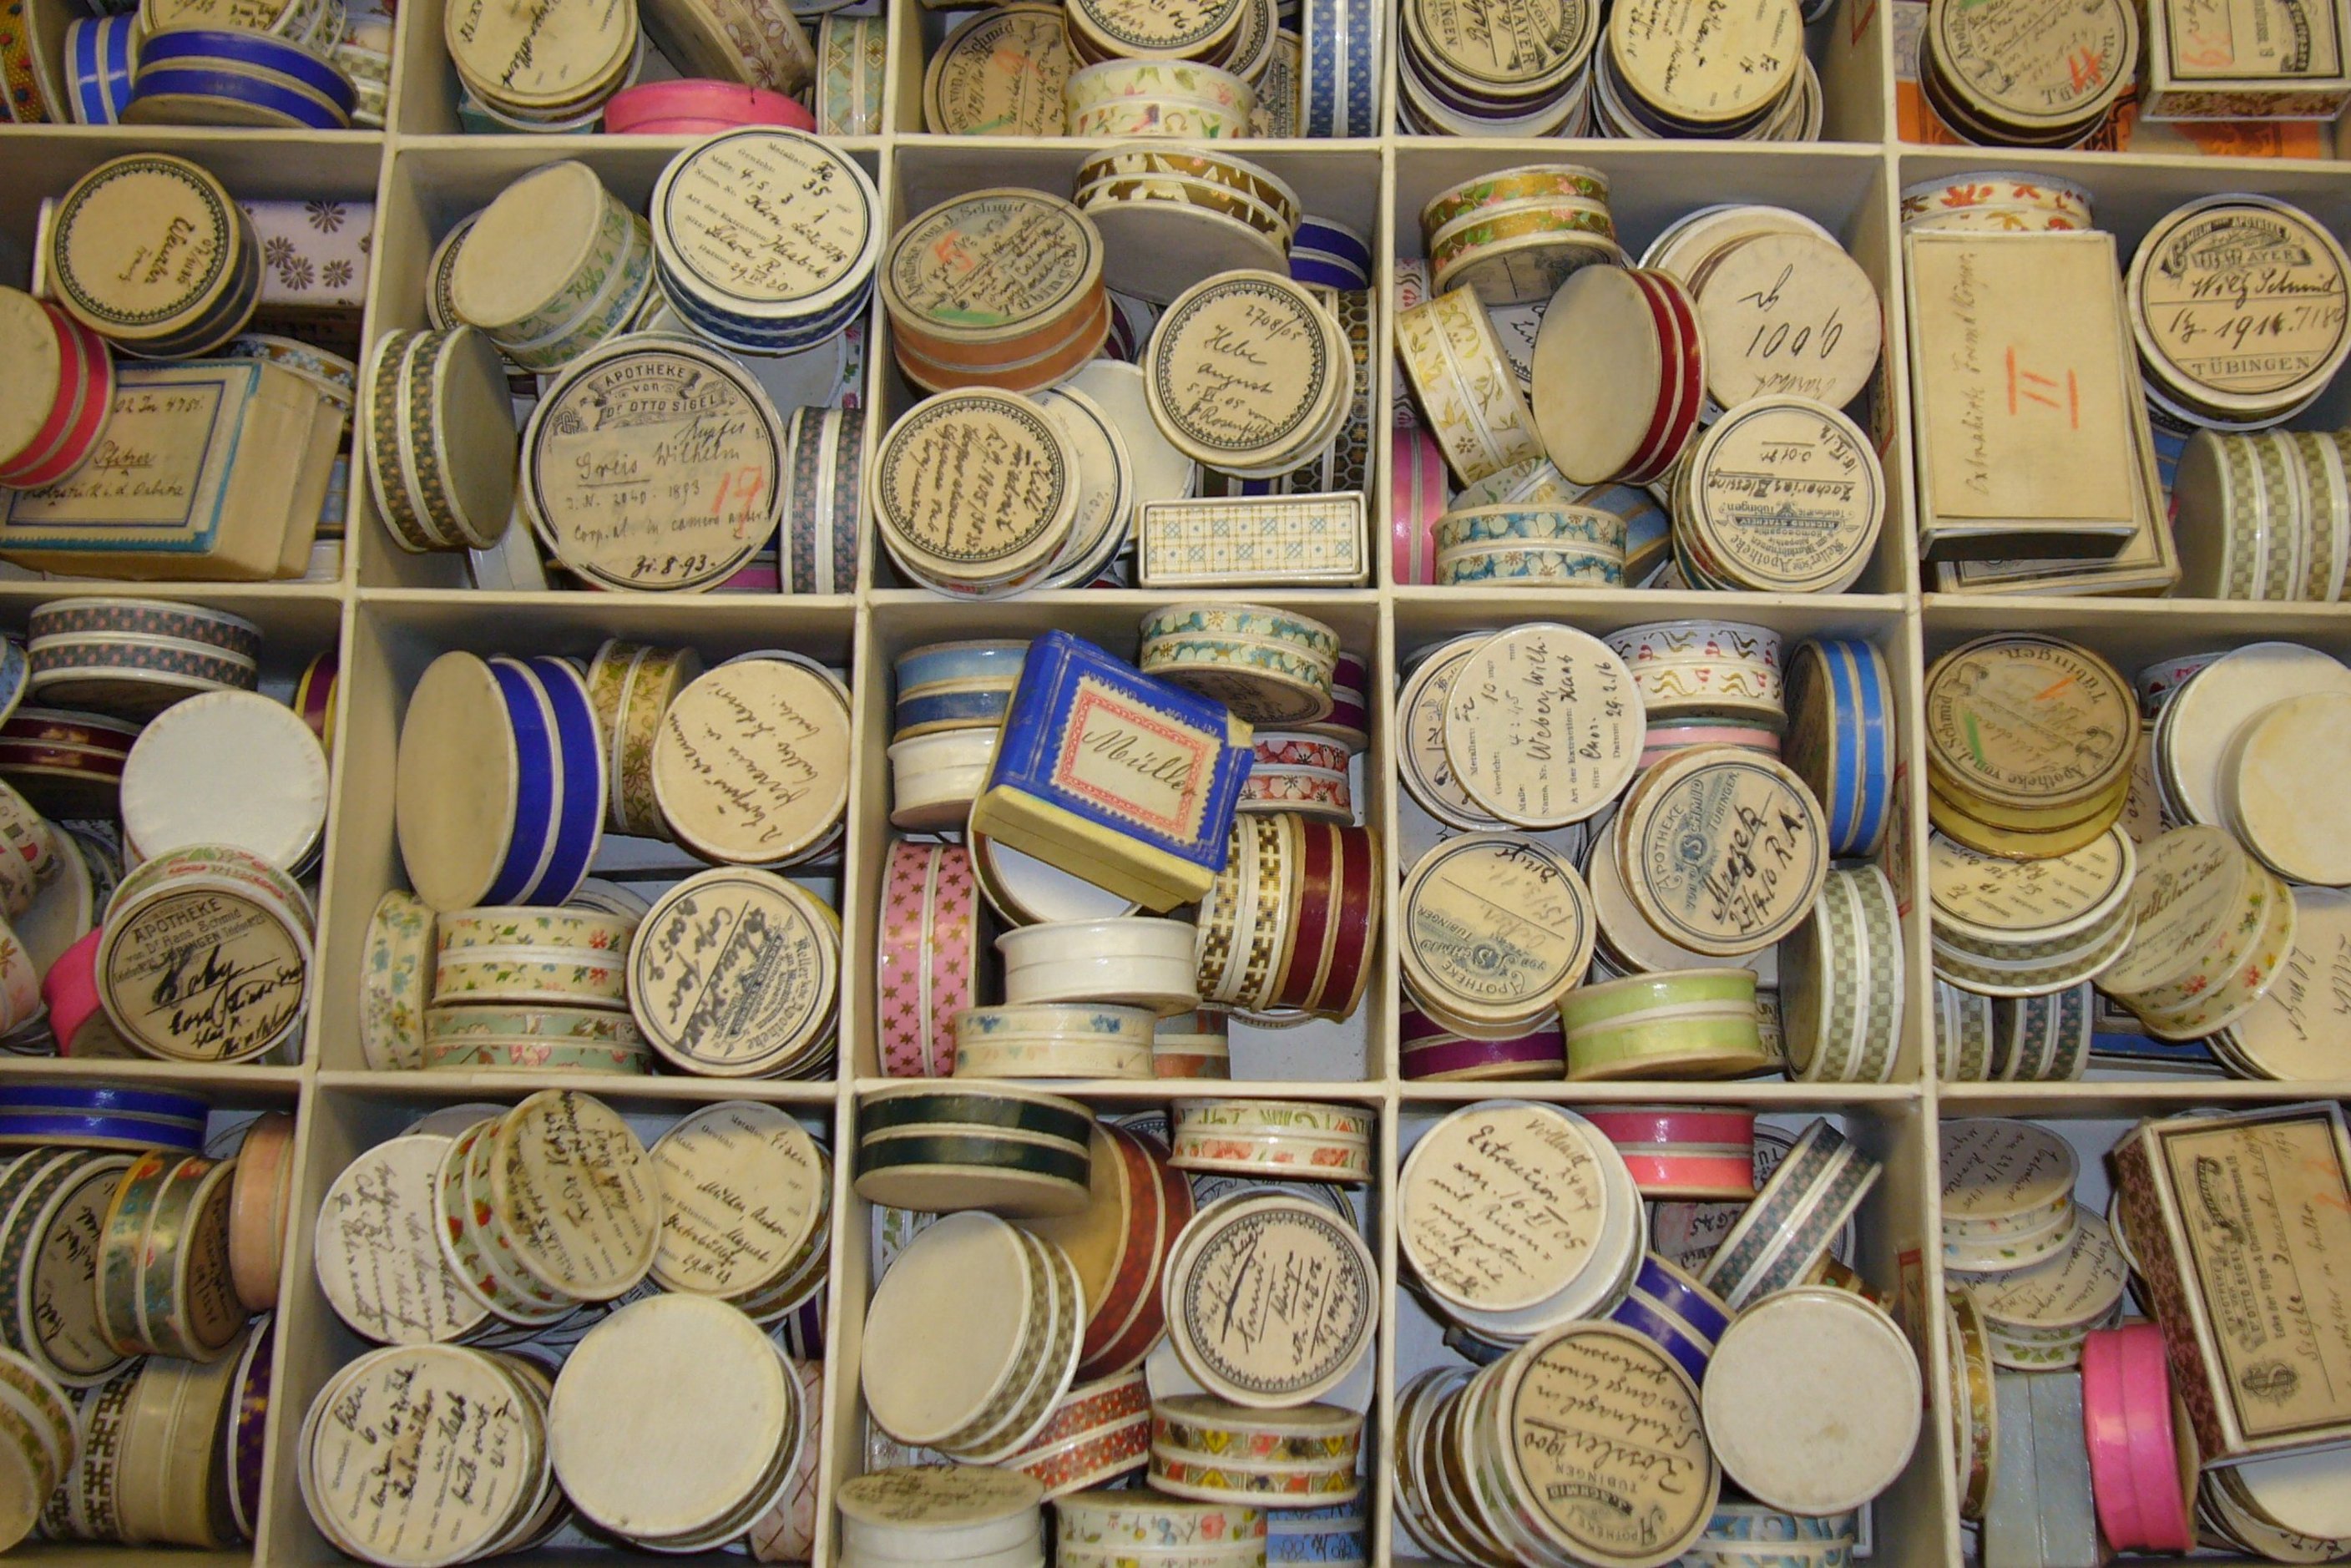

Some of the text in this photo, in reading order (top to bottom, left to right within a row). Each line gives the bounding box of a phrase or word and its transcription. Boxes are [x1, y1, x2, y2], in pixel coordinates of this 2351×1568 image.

[605, 359, 685, 387] APOTHEKE
[2192, 351, 2309, 378] TÜBINGEN
[672, 396, 716, 412] SIGEL
[1727, 536, 1792, 572] Apotheke
[1526, 690, 1556, 761] Weber,
[1924, 695, 1957, 748] Schmid
[1643, 807, 1709, 890] APOTHEKE
[132, 898, 220, 943] APOTHEKE
[1443, 943, 1524, 1006] APOTHEKE
[2230, 1246, 2247, 1286] SIGEL
